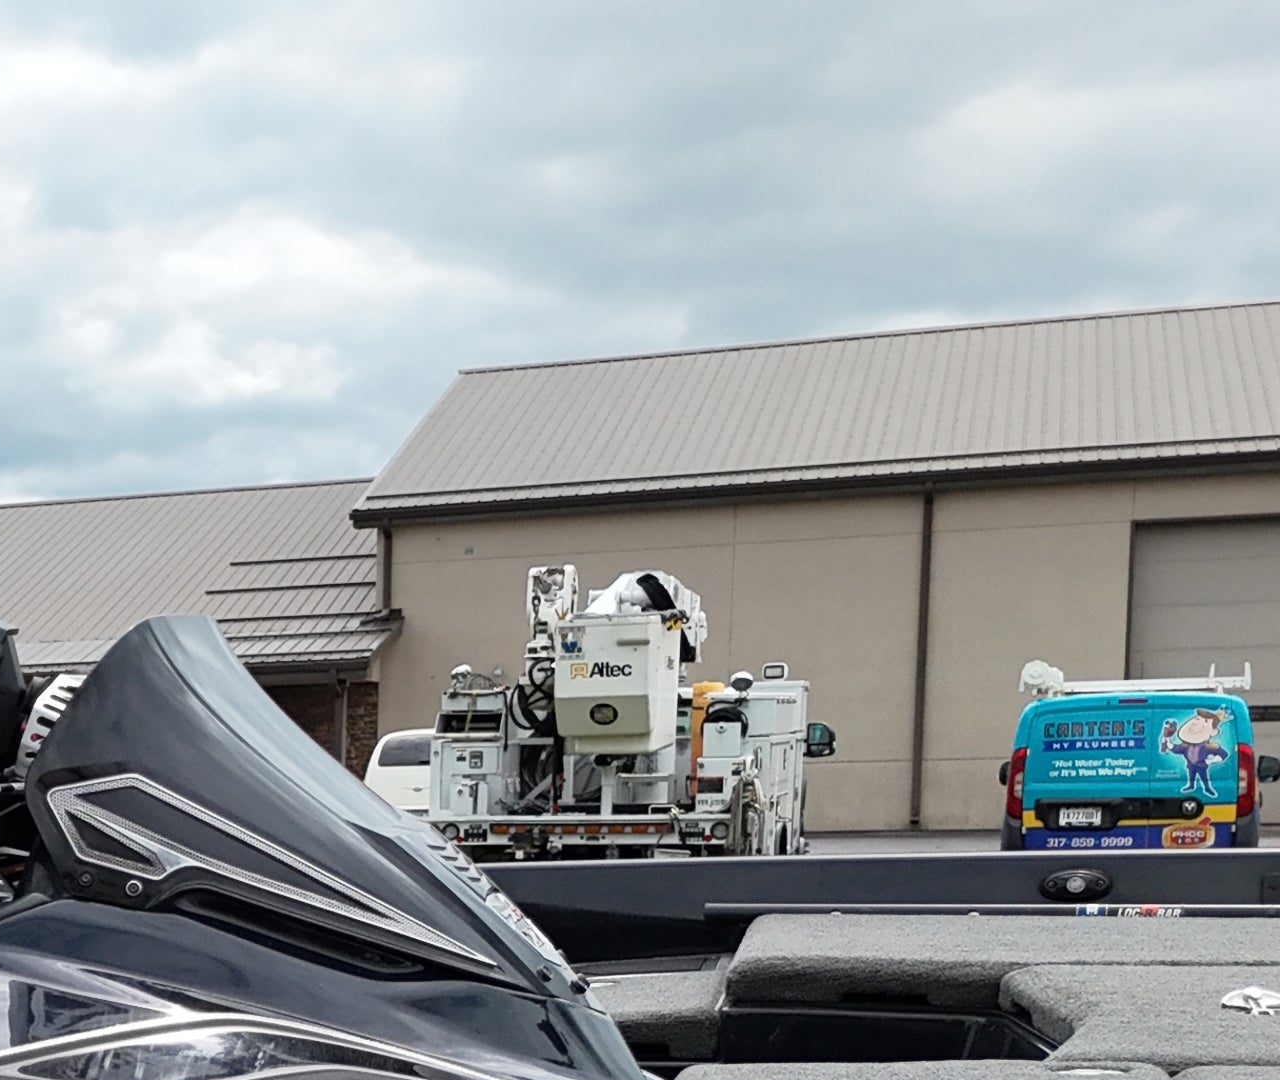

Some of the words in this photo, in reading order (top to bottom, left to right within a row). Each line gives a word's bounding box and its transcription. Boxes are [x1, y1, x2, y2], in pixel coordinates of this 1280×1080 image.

[590, 662, 633, 678] Altec
[1044, 720, 1145, 738] CARTER'S
[1076, 740, 1135, 748] PLUMBER
[1105, 759, 1135, 767] Today
